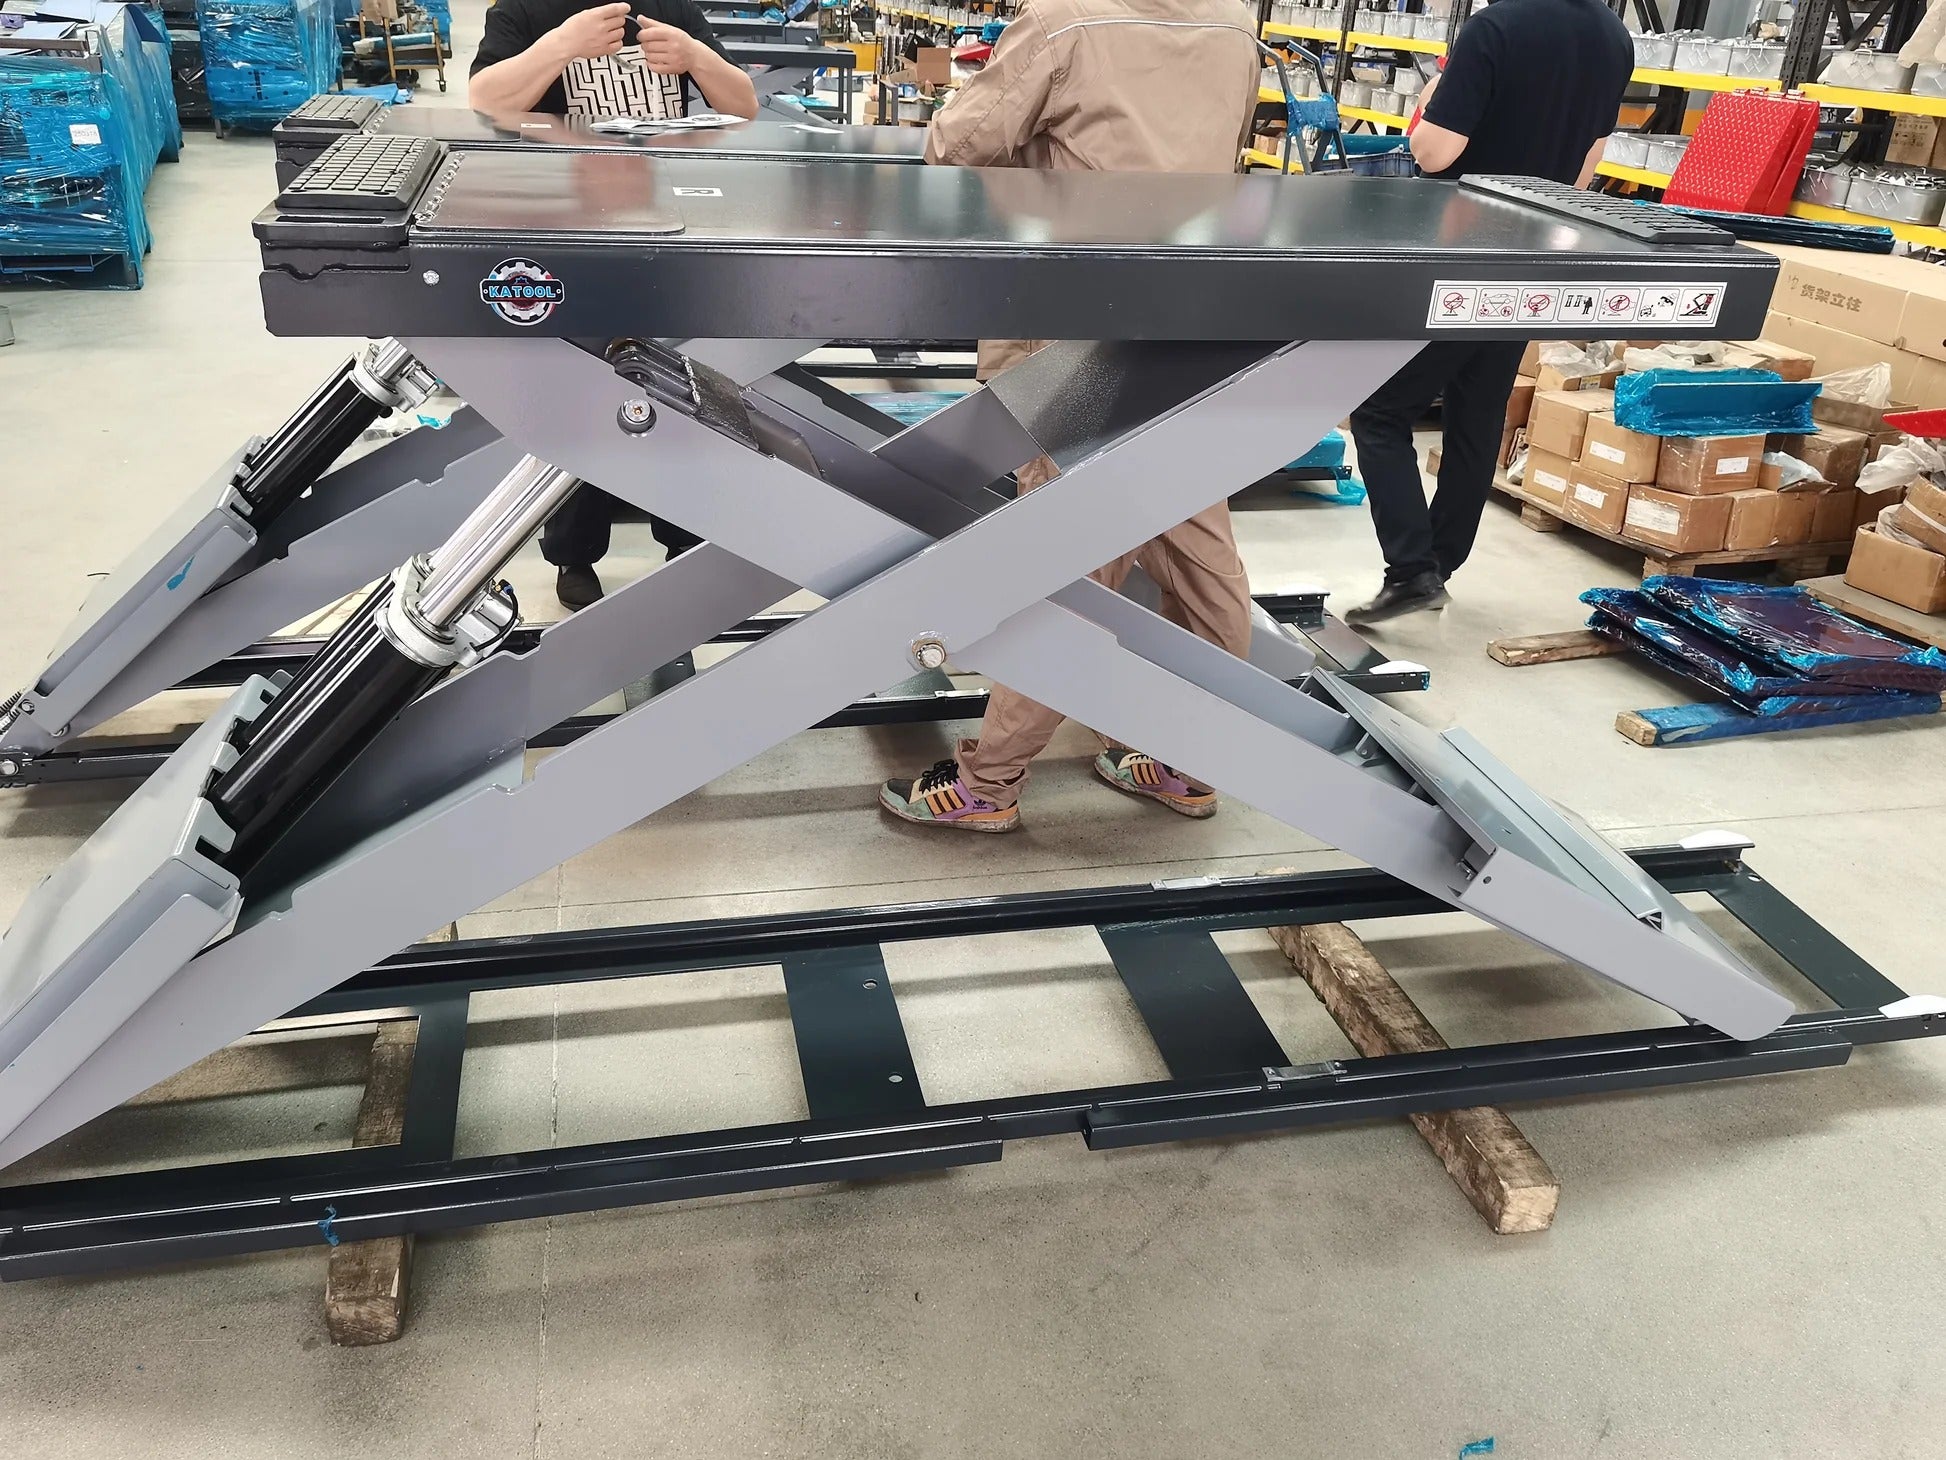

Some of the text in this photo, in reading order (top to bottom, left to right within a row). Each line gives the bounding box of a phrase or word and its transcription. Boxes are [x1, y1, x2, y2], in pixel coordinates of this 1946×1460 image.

[488, 285, 556, 298] KATOOL
[1800, 283, 1862, 312] 货架立柱
